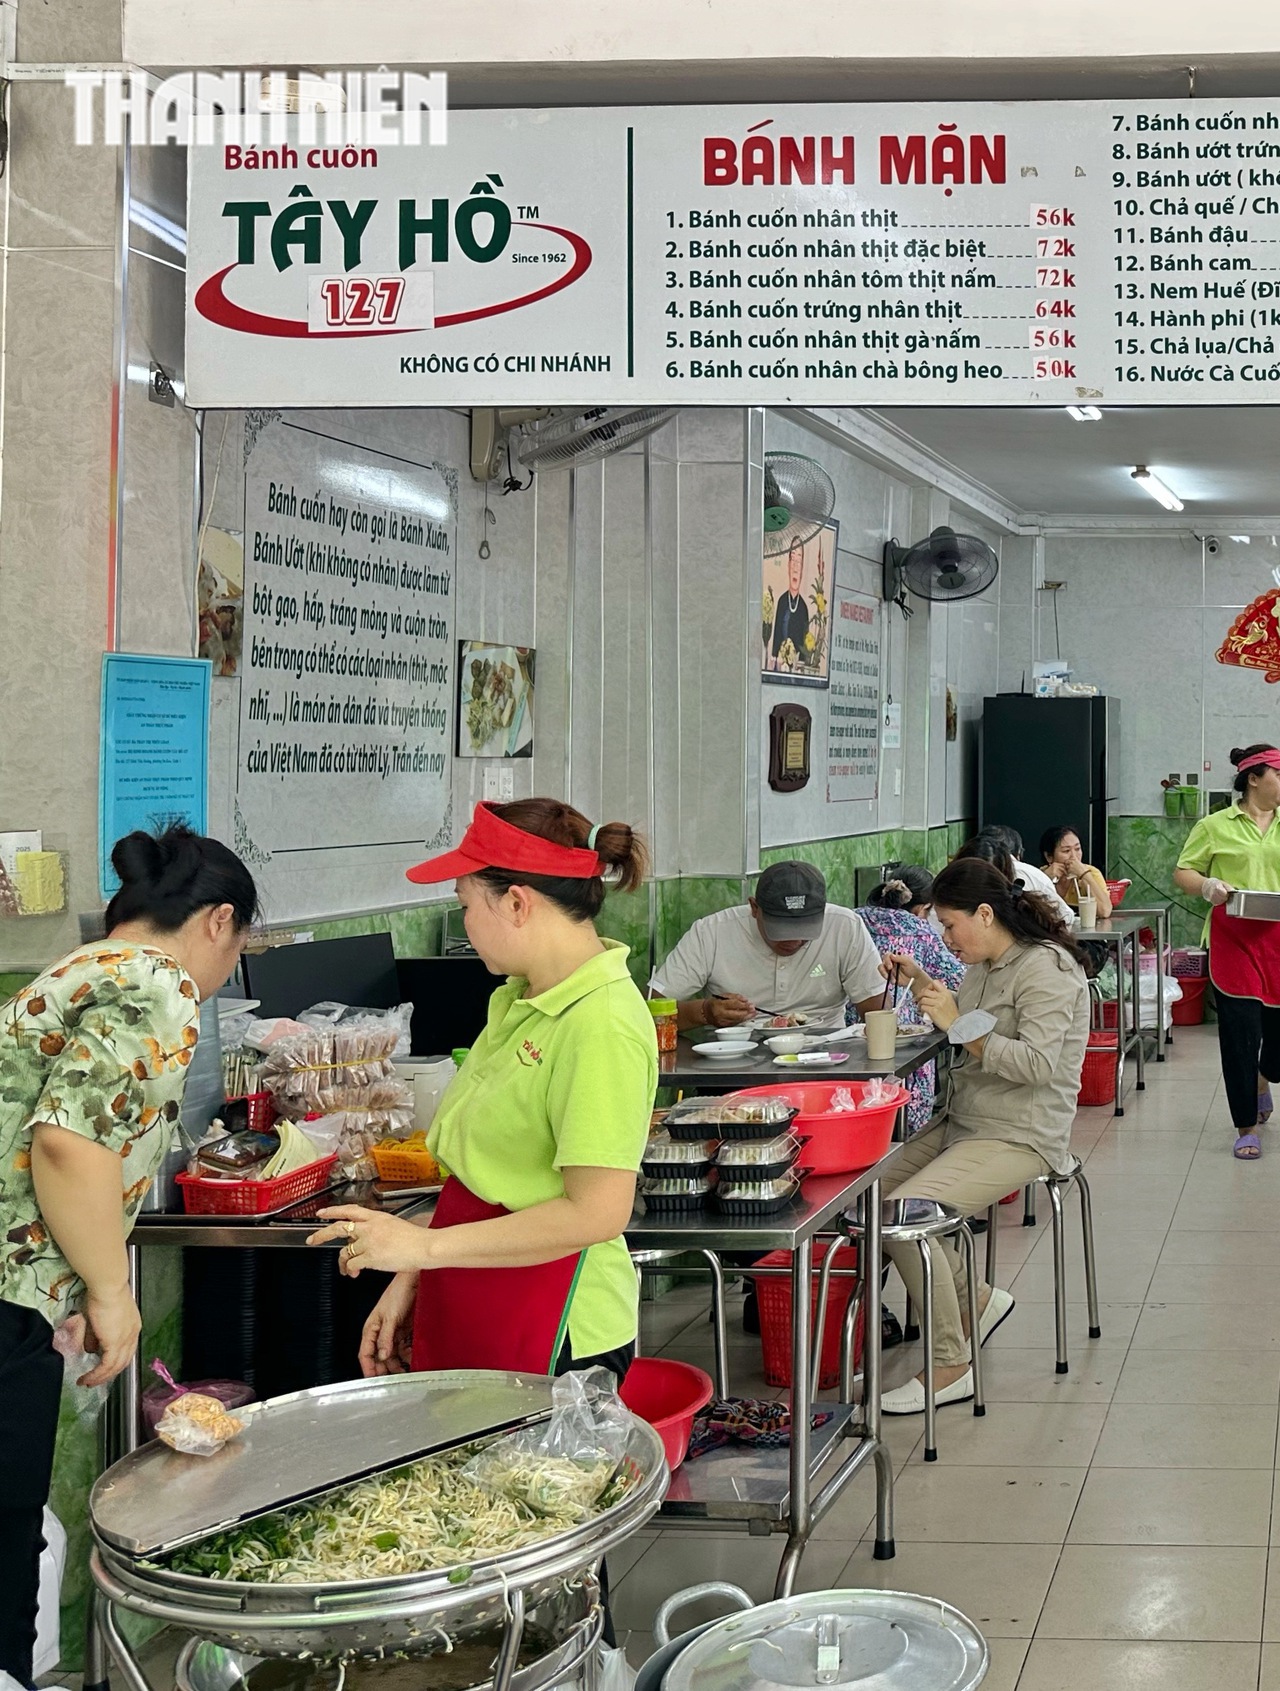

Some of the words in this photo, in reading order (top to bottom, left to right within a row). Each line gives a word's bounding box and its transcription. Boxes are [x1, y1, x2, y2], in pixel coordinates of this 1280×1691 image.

[1113, 116, 1130, 131] 7.
[1137, 114, 1189, 131] Bánh
[1196, 111, 1245, 130] cuốn
[226, 144, 297, 170] Bánh
[704, 120, 854, 186] BÁNH
[880, 124, 1006, 196] MẶN
[222, 185, 377, 273] TÂY
[399, 174, 511, 273] HỒ
[667, 212, 683, 228] 1.
[690, 210, 741, 228] Bánh
[747, 207, 797, 227] cuốn
[804, 209, 855, 227] nhân
[861, 209, 897, 232] thịt
[1114, 228, 1144, 243] 11.
[1151, 226, 1202, 243] Bánh
[1209, 226, 1247, 247] đậu
[513, 254, 538, 263] Since
[542, 254, 566, 262] 1962
[666, 242, 683, 258] 2.
[690, 240, 741, 258] Bánh
[748, 238, 797, 257] cuốn
[804, 240, 855, 257] nhân
[862, 240, 898, 262] thịt
[904, 239, 939, 262] đặc
[946, 239, 986, 262] biệt
[321, 277, 405, 326] 127
[1115, 312, 1144, 326] 14.
[1151, 310, 1204, 326] Hành
[1212, 309, 1243, 330] phi
[401, 354, 468, 373] KHÔNG
[474, 353, 499, 372] CÓ
[505, 356, 535, 372] CHI
[542, 353, 610, 372] NHÁNH
[1115, 367, 1144, 381] 16.
[1151, 365, 1203, 381] Nước
[1210, 365, 1234, 381] Cà
